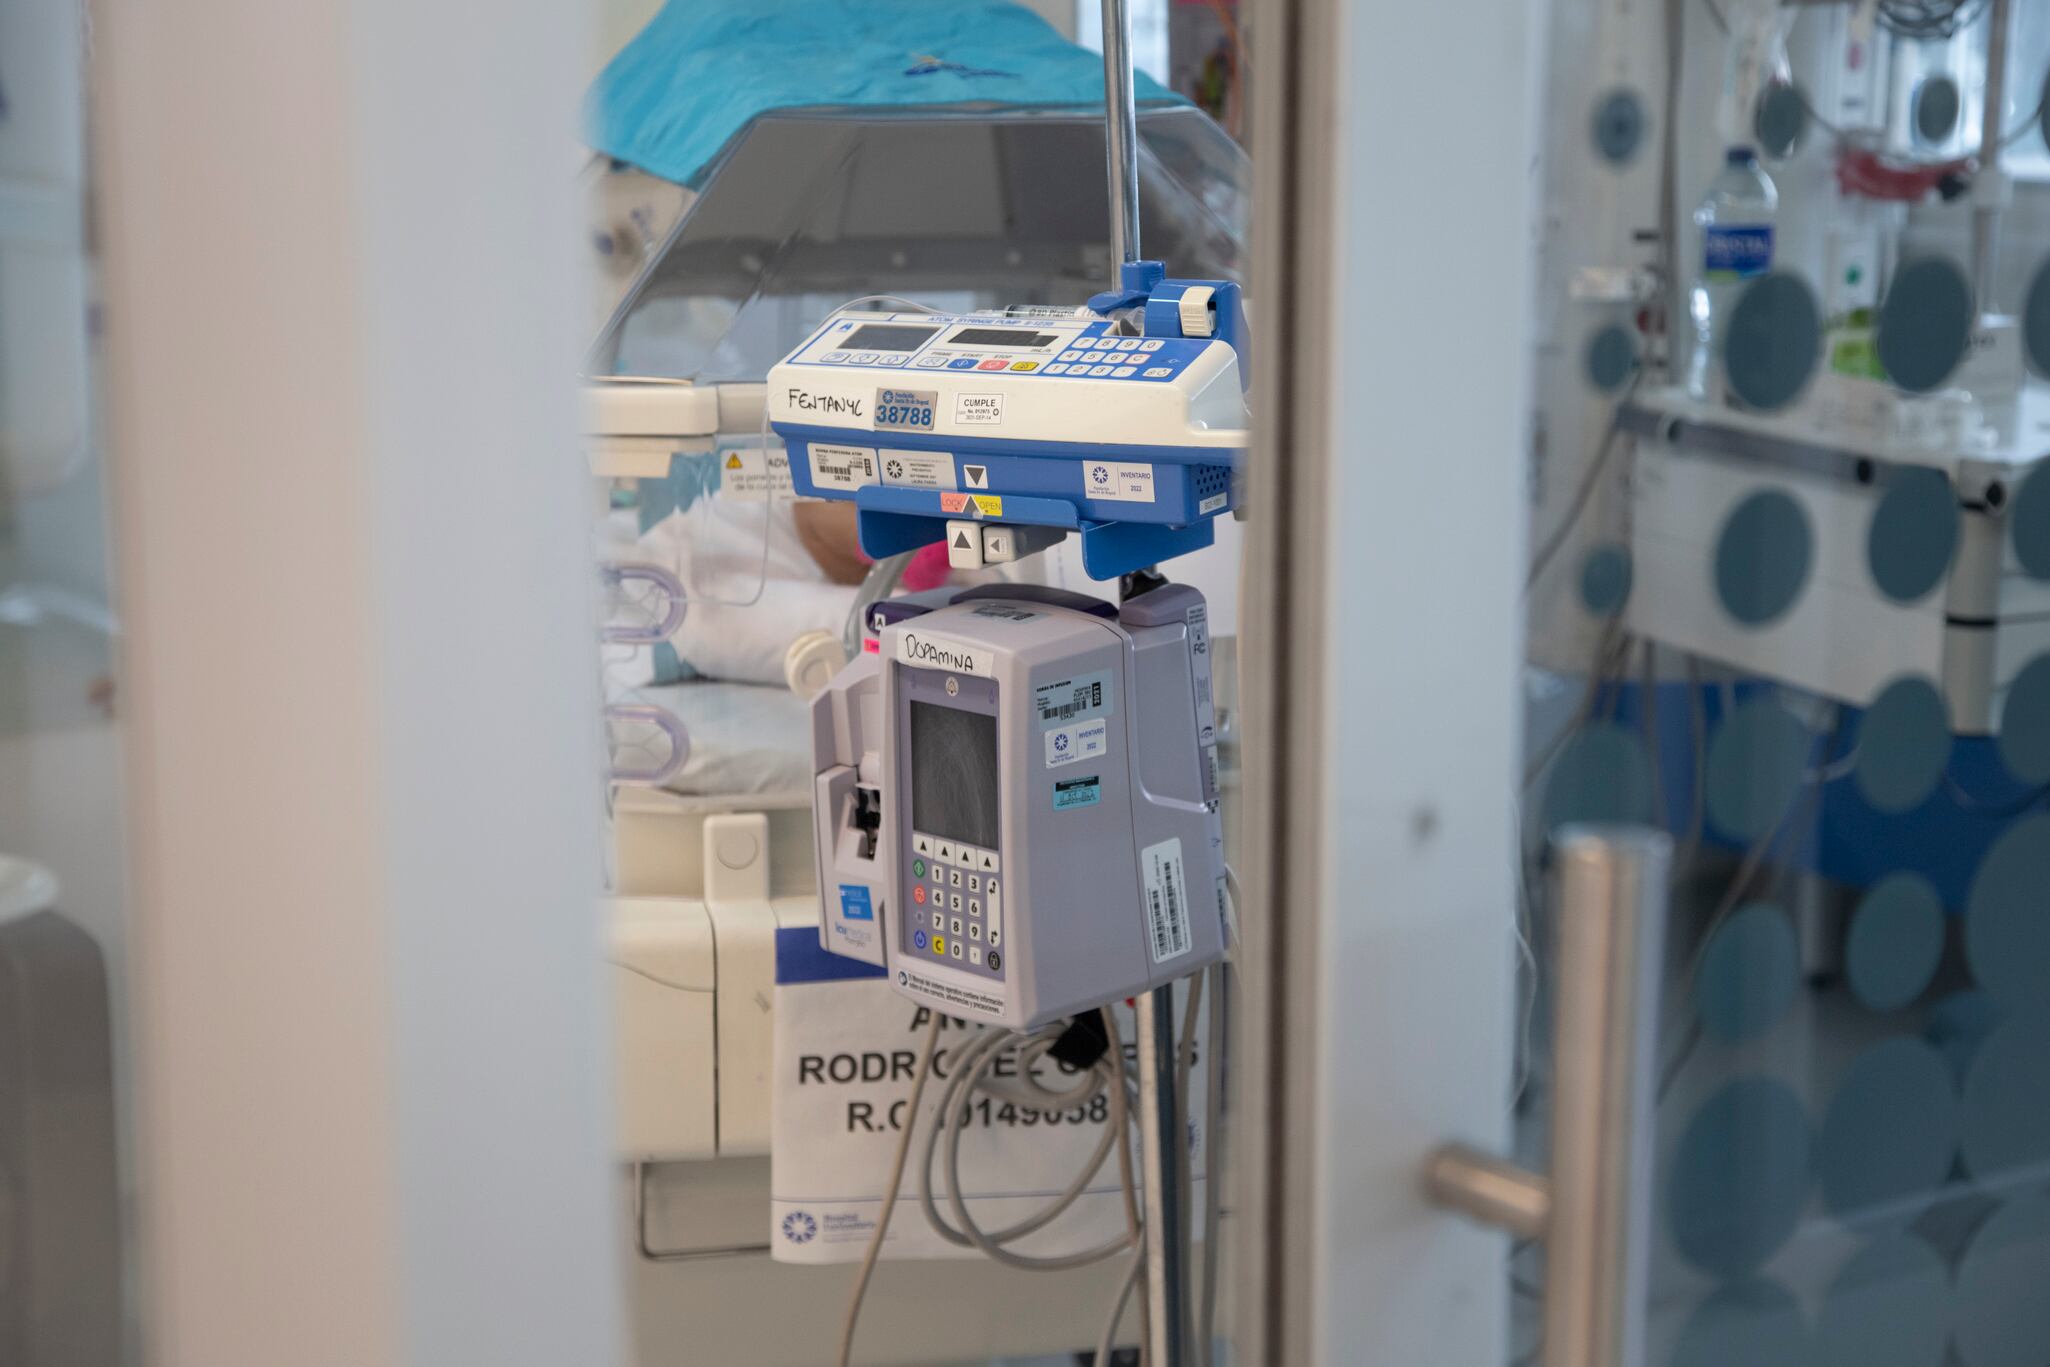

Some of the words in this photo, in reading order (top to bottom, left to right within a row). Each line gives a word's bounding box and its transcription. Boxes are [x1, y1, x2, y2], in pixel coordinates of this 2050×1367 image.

[964, 399, 996, 407] CUMPLE
[876, 405, 932, 426] 38788
[1120, 472, 1150, 480] INVENTARIO
[877, 617, 884, 626] A
[905, 634, 974, 672] DOPAMINA
[952, 873, 959, 885] 2
[971, 878, 977, 889] 3
[953, 897, 959, 908] 5
[971, 902, 977, 913] 6
[935, 916, 941, 927] 7
[953, 921, 960, 932] 8
[971, 926, 978, 937] 9
[935, 940, 942, 952] C
[953, 945, 960, 956] 0
